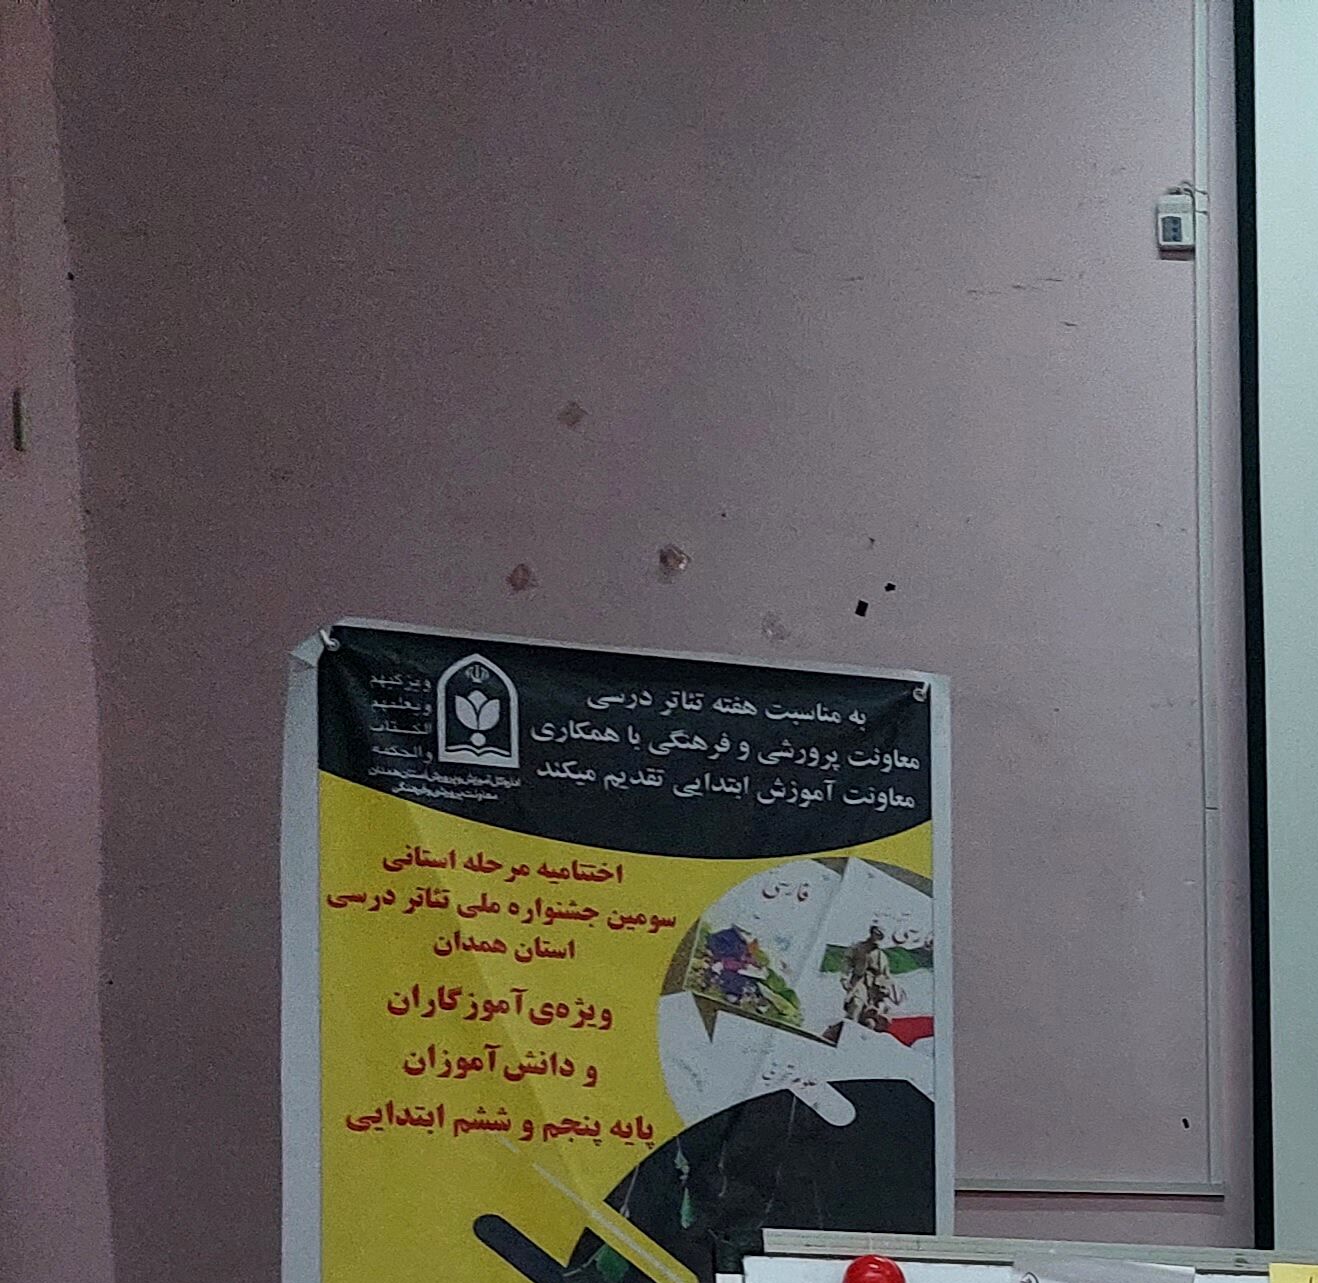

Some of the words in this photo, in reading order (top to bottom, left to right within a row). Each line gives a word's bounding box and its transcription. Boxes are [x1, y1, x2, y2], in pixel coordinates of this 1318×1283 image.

[587, 689, 652, 711] درسی
[661, 690, 703, 716] تئاتر
[713, 696, 757, 716] هفته
[765, 702, 842, 724] مناسبت
[530, 719, 620, 743] همکاری
[849, 709, 867, 732] به
[627, 726, 641, 751] با
[647, 730, 730, 760] فرهنگی
[739, 741, 749, 761] و
[757, 742, 839, 772] پرورشی
[847, 746, 921, 773] معاونت
[536, 760, 597, 787] میکند
[603, 767, 665, 793] تقدیم
[672, 772, 749, 799] ابتدایی
[757, 779, 834, 808] آموزش
[843, 787, 915, 812] معاونت
[382, 846, 456, 872] استانی
[463, 851, 530, 882] مرحله
[537, 859, 623, 884] اختتامیه
[327, 888, 396, 912] درسی
[403, 886, 450, 915] تئاتر
[457, 892, 500, 918] ملی
[507, 898, 599, 928] جشنواره
[607, 909, 677, 933] سومین
[433, 930, 507, 957] همدان
[514, 936, 575, 963] استان
[387, 983, 528, 1022] آموزگاران
[582, 1063, 598, 1087] و
[346, 1099, 445, 1133] ابتدایی
[453, 1105, 512, 1136] ششم
[518, 1119, 534, 1141] و
[542, 1115, 601, 1146] پنجم
[609, 1115, 655, 1149] پایه
